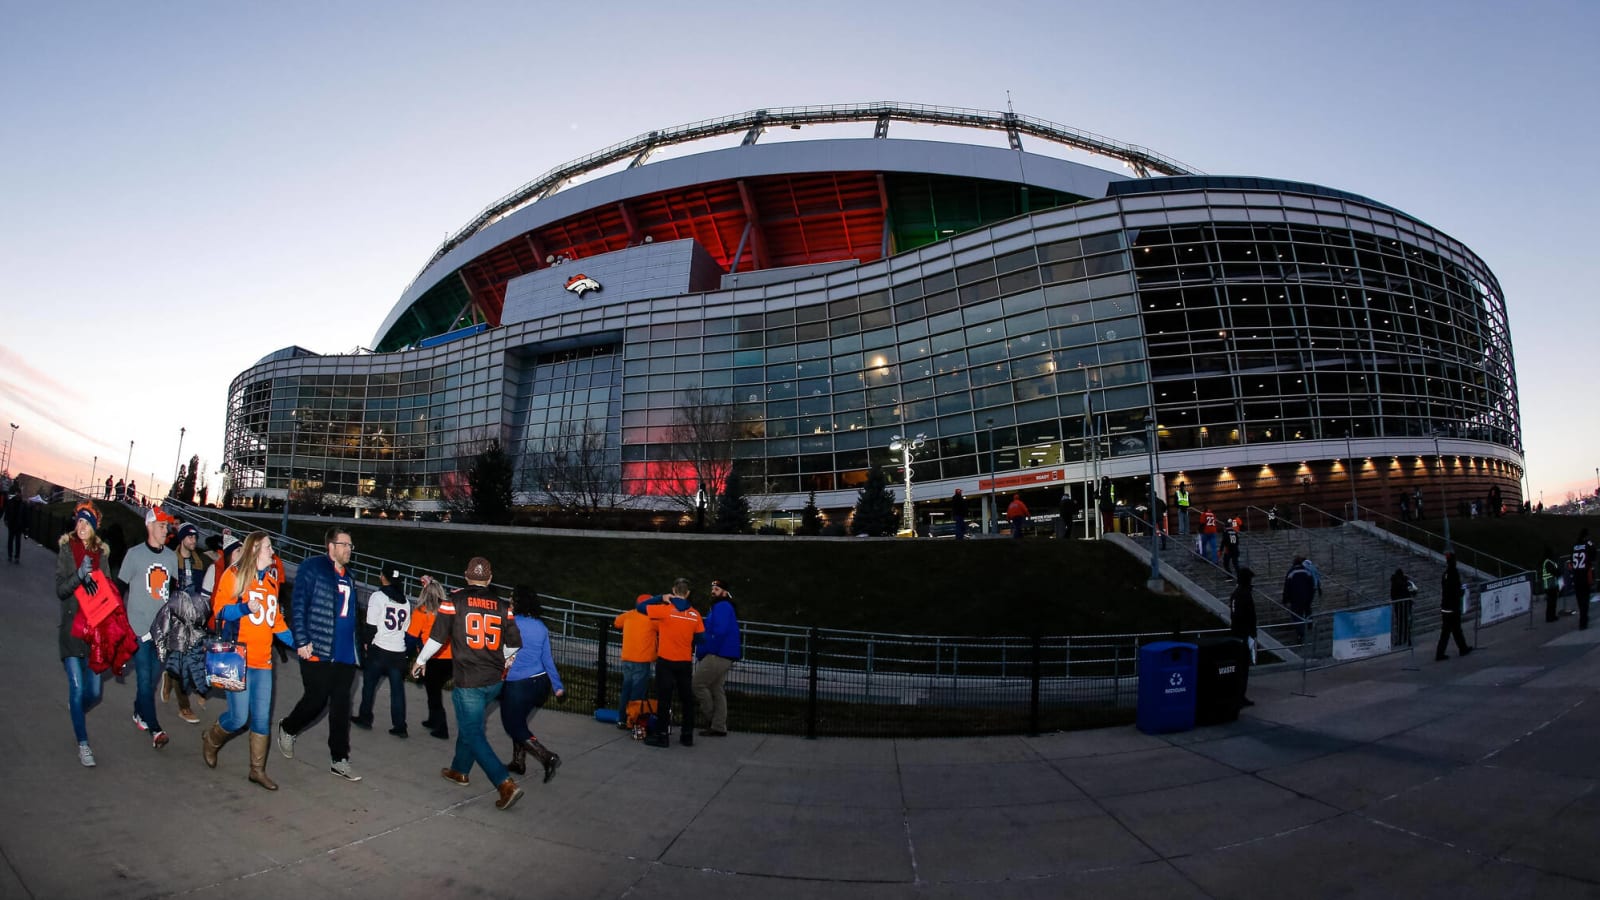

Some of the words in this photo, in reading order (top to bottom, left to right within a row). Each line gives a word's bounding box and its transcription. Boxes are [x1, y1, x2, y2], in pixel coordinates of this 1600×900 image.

[1572, 552, 1586, 569] 52
[247, 590, 278, 627] 58
[337, 584, 351, 617] 7
[467, 596, 498, 610] GARRETT
[465, 612, 502, 651] 95
[1218, 665, 1236, 675] WASTE
